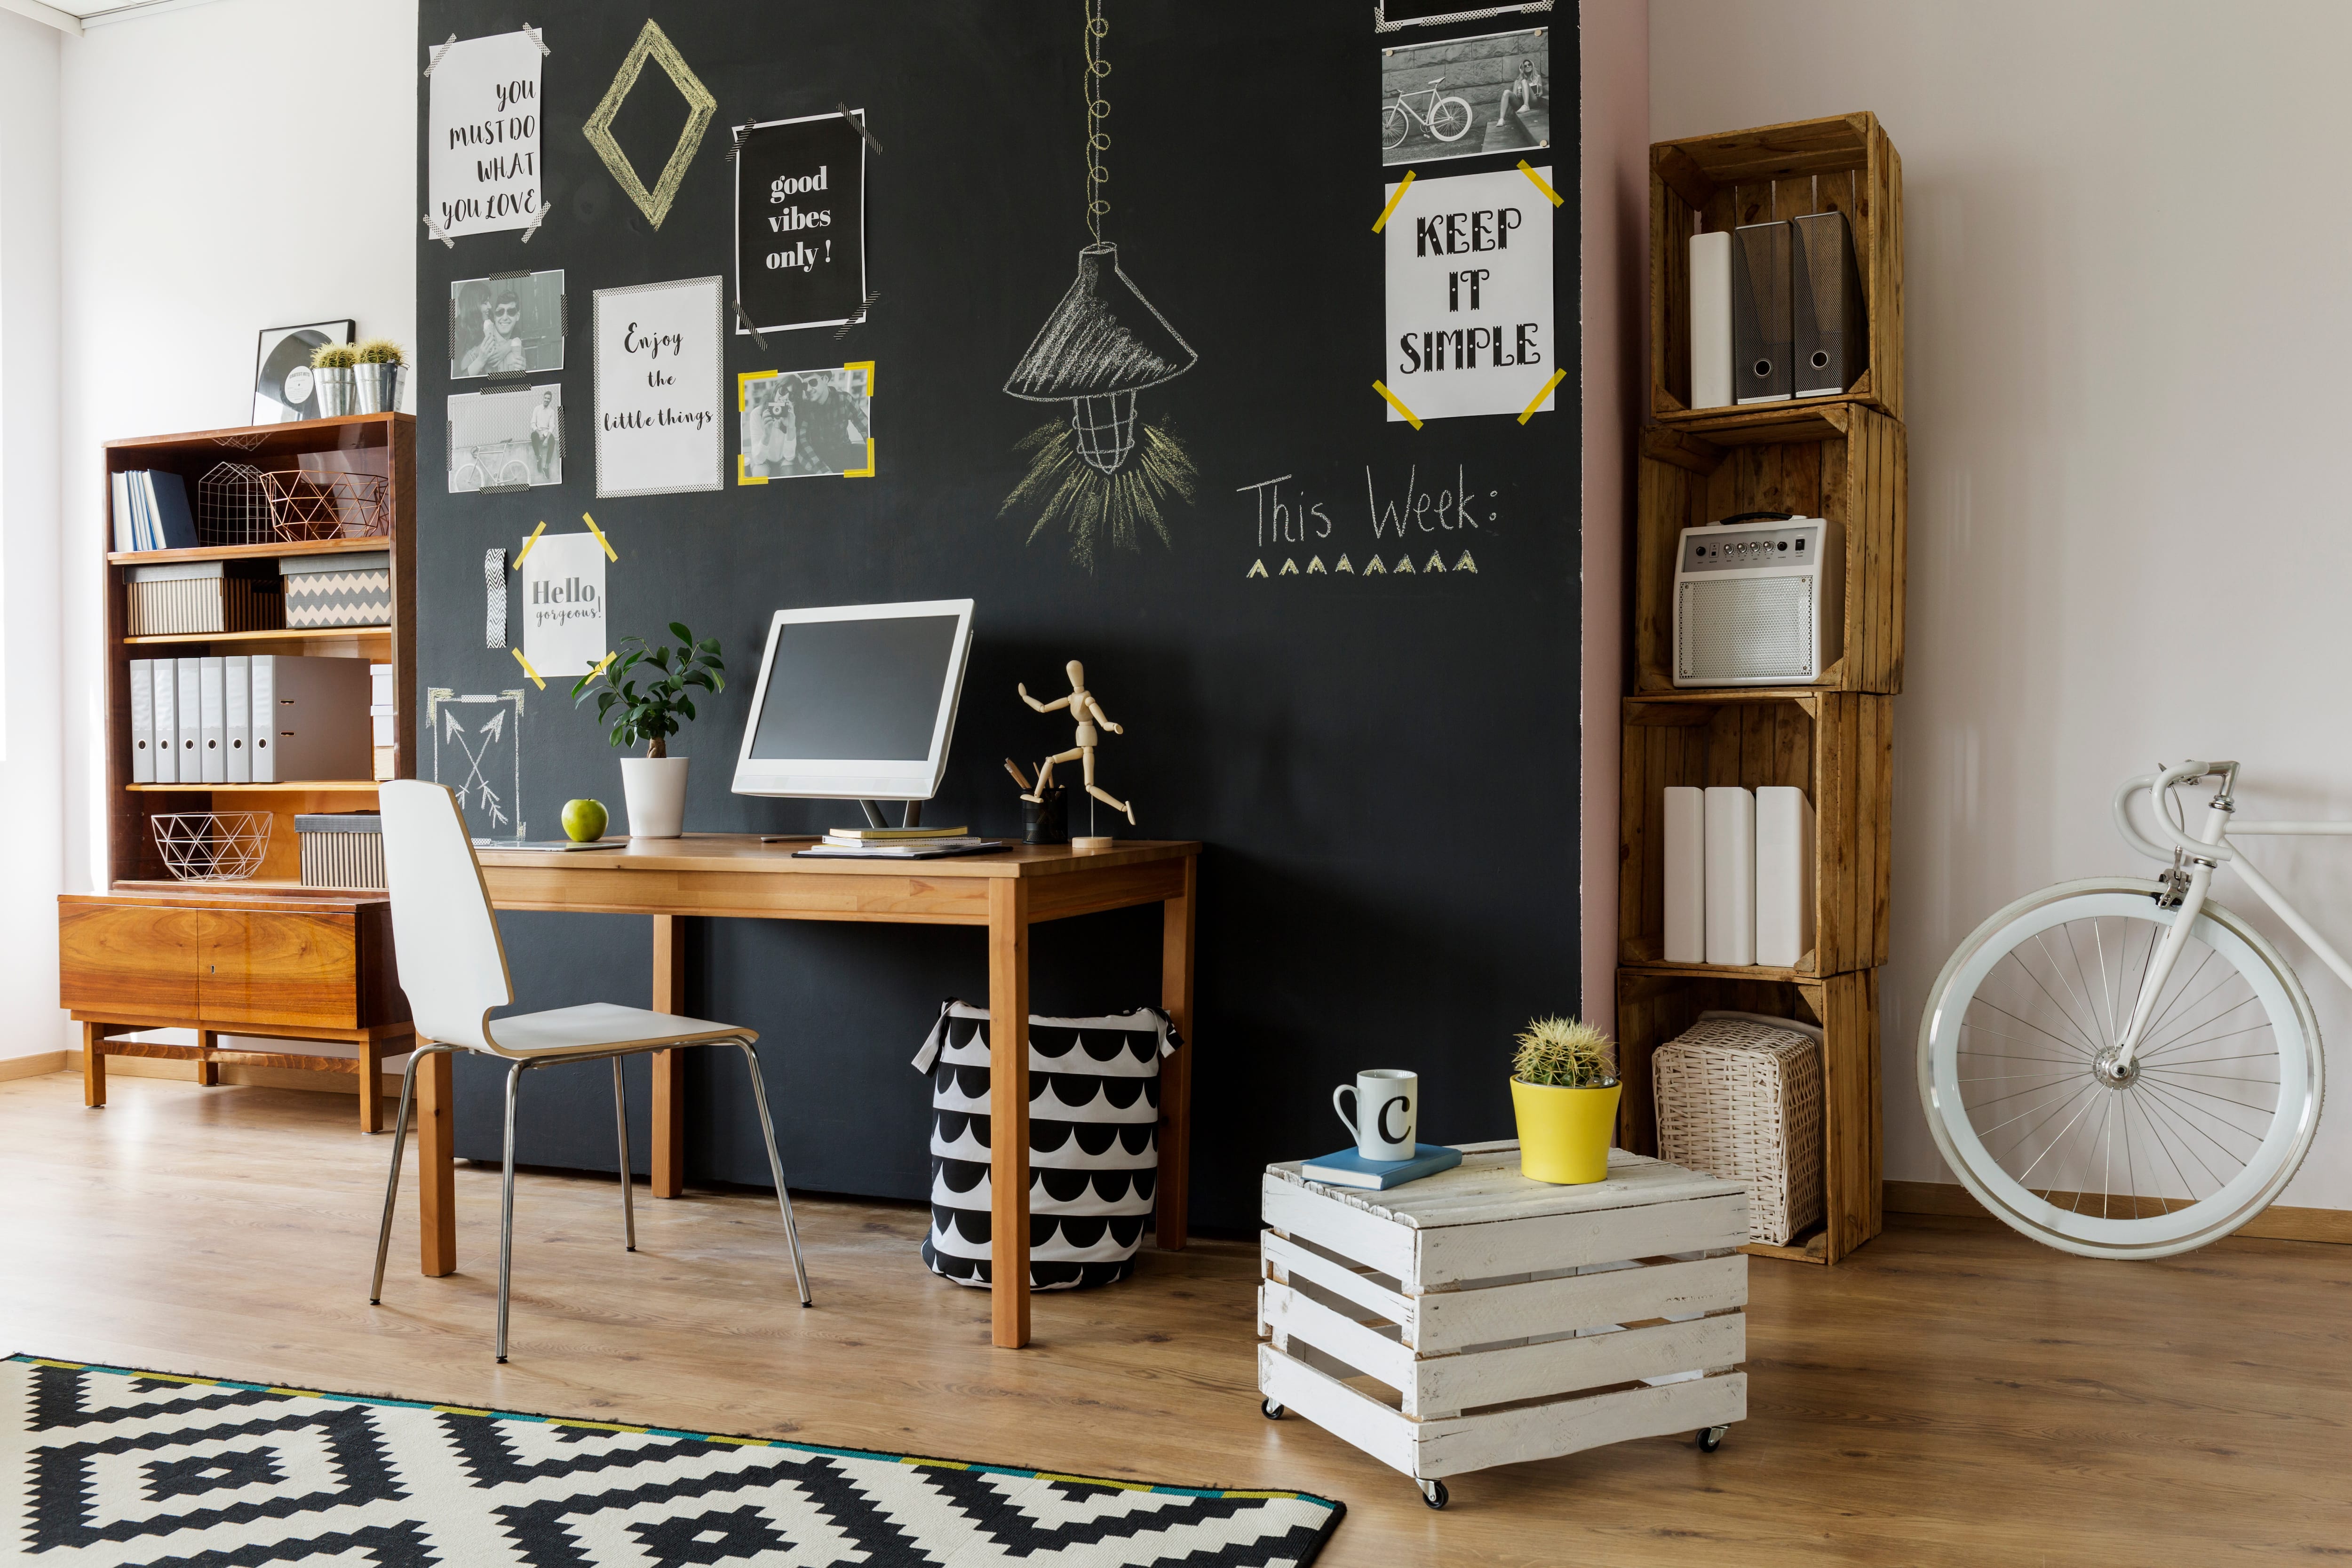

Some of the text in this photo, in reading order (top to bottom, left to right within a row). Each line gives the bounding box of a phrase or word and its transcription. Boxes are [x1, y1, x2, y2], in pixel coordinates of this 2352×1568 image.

[496, 80, 535, 112] YOU
[450, 115, 535, 150] MUST DO
[477, 152, 534, 183] WHAT
[770, 165, 828, 204] good
[442, 189, 536, 230] YOU LOVE
[768, 206, 831, 232] vibes
[1417, 207, 1522, 258] KEEP
[1449, 269, 1490, 312] IT
[624, 322, 683, 359] Enjoy
[1400, 323, 1541, 374] SIMPLE
[648, 370, 676, 388] the
[604, 407, 713, 431] little things
[1236, 464, 1498, 547] This Week:
[532, 577, 595, 605] Hello
[536, 596, 601, 627] gorgeous!
[1378, 1095, 1411, 1145] C
